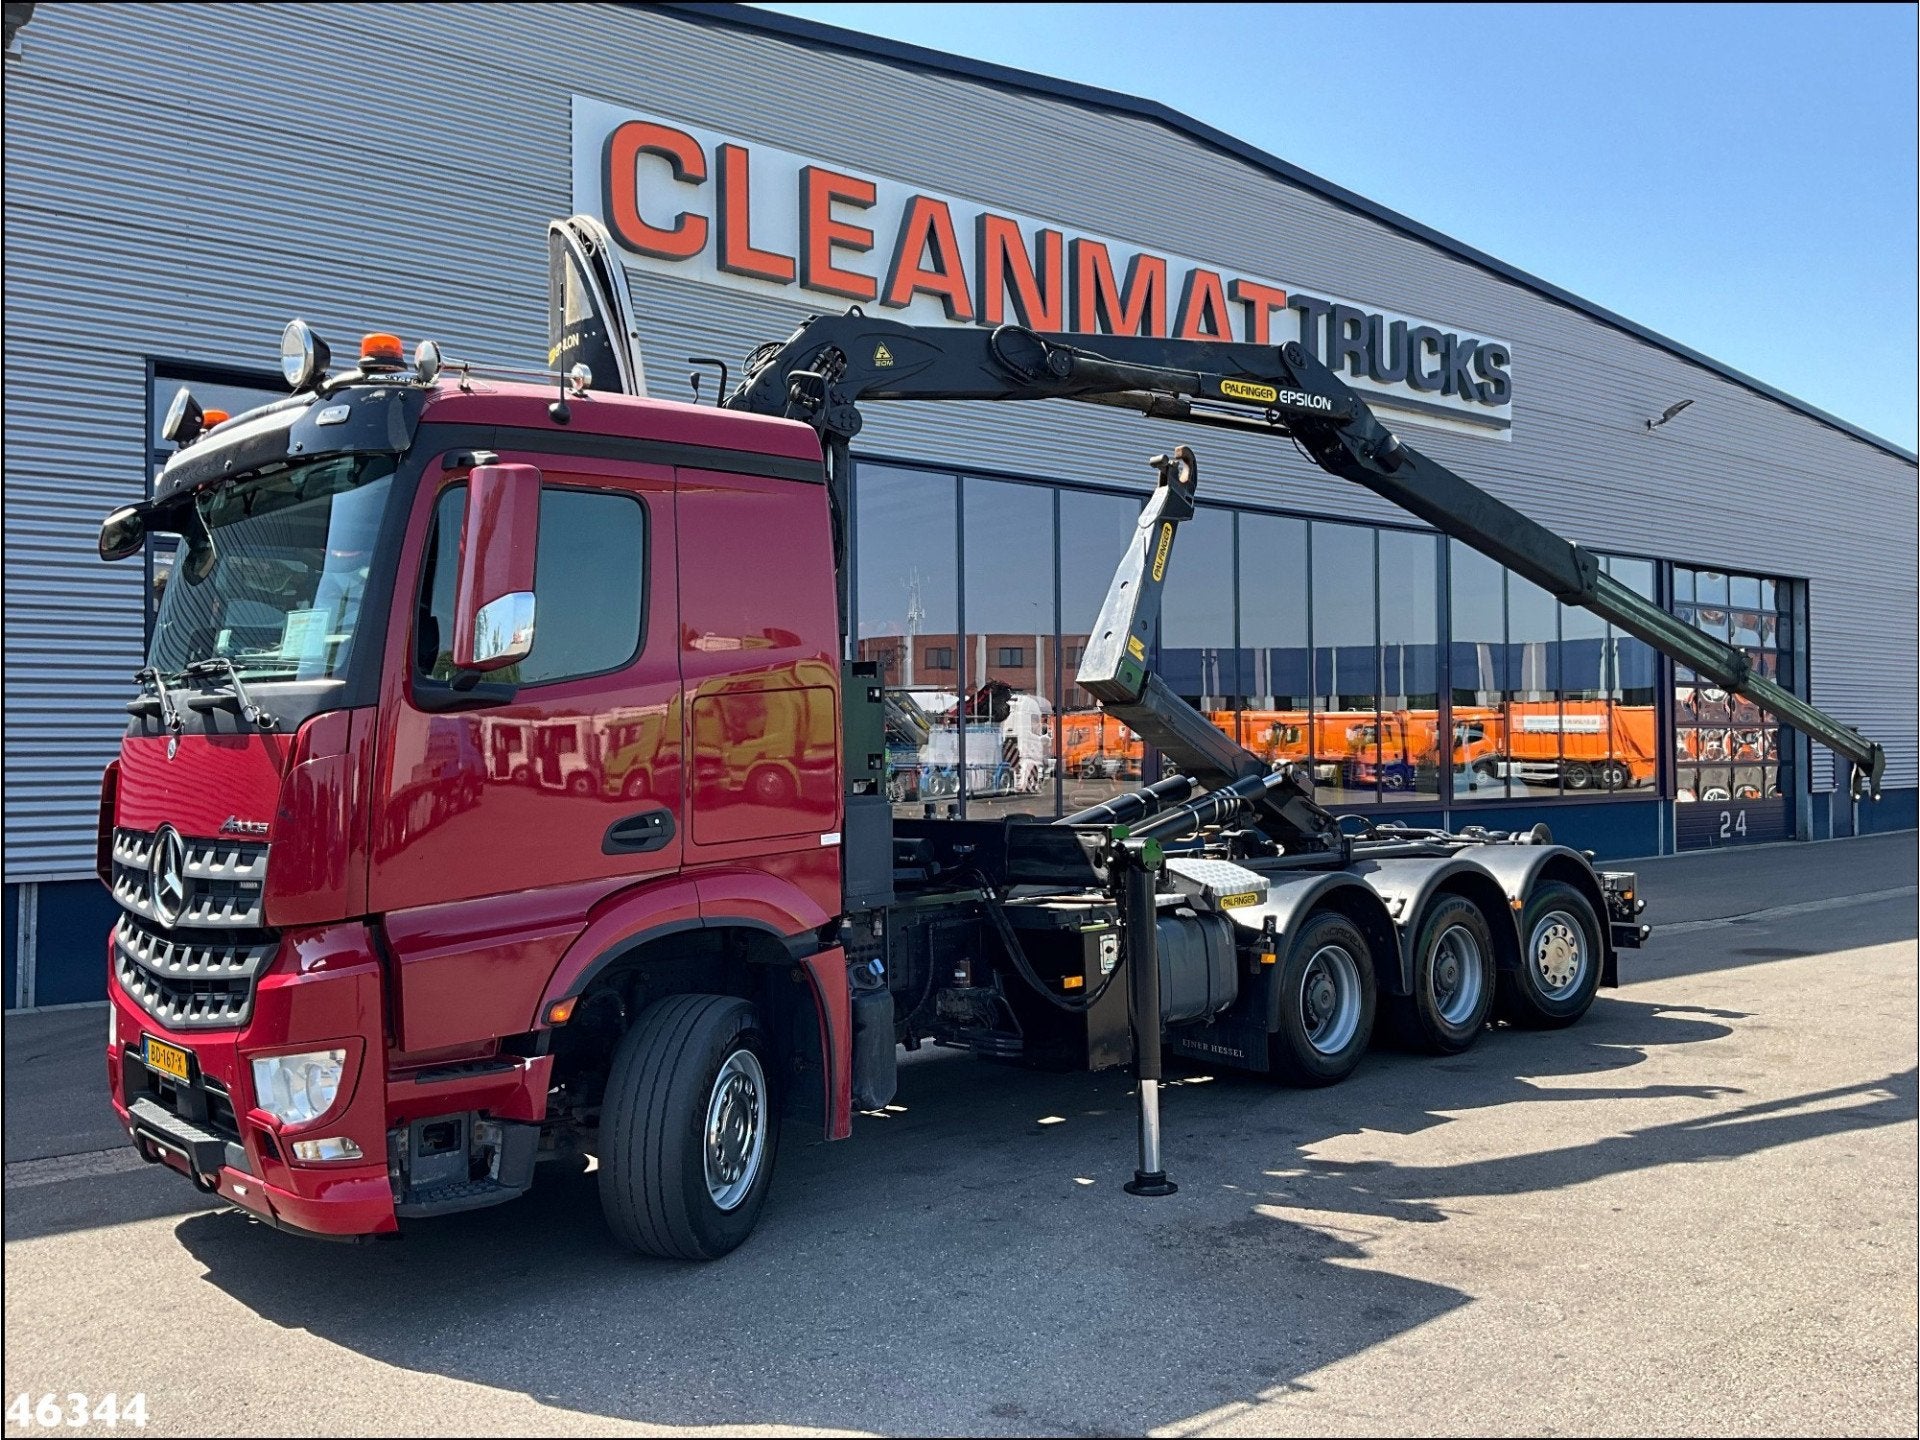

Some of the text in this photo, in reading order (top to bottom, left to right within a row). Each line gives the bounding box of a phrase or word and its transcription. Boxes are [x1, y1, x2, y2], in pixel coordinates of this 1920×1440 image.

[1287, 293, 1513, 408] TRUCKS
[1224, 382, 1332, 411] PALFINGER EPSILON
[1154, 526, 1171, 578] PALFINGER
[1720, 810, 1747, 838] 24
[1210, 1044, 1245, 1058] HESSEL
